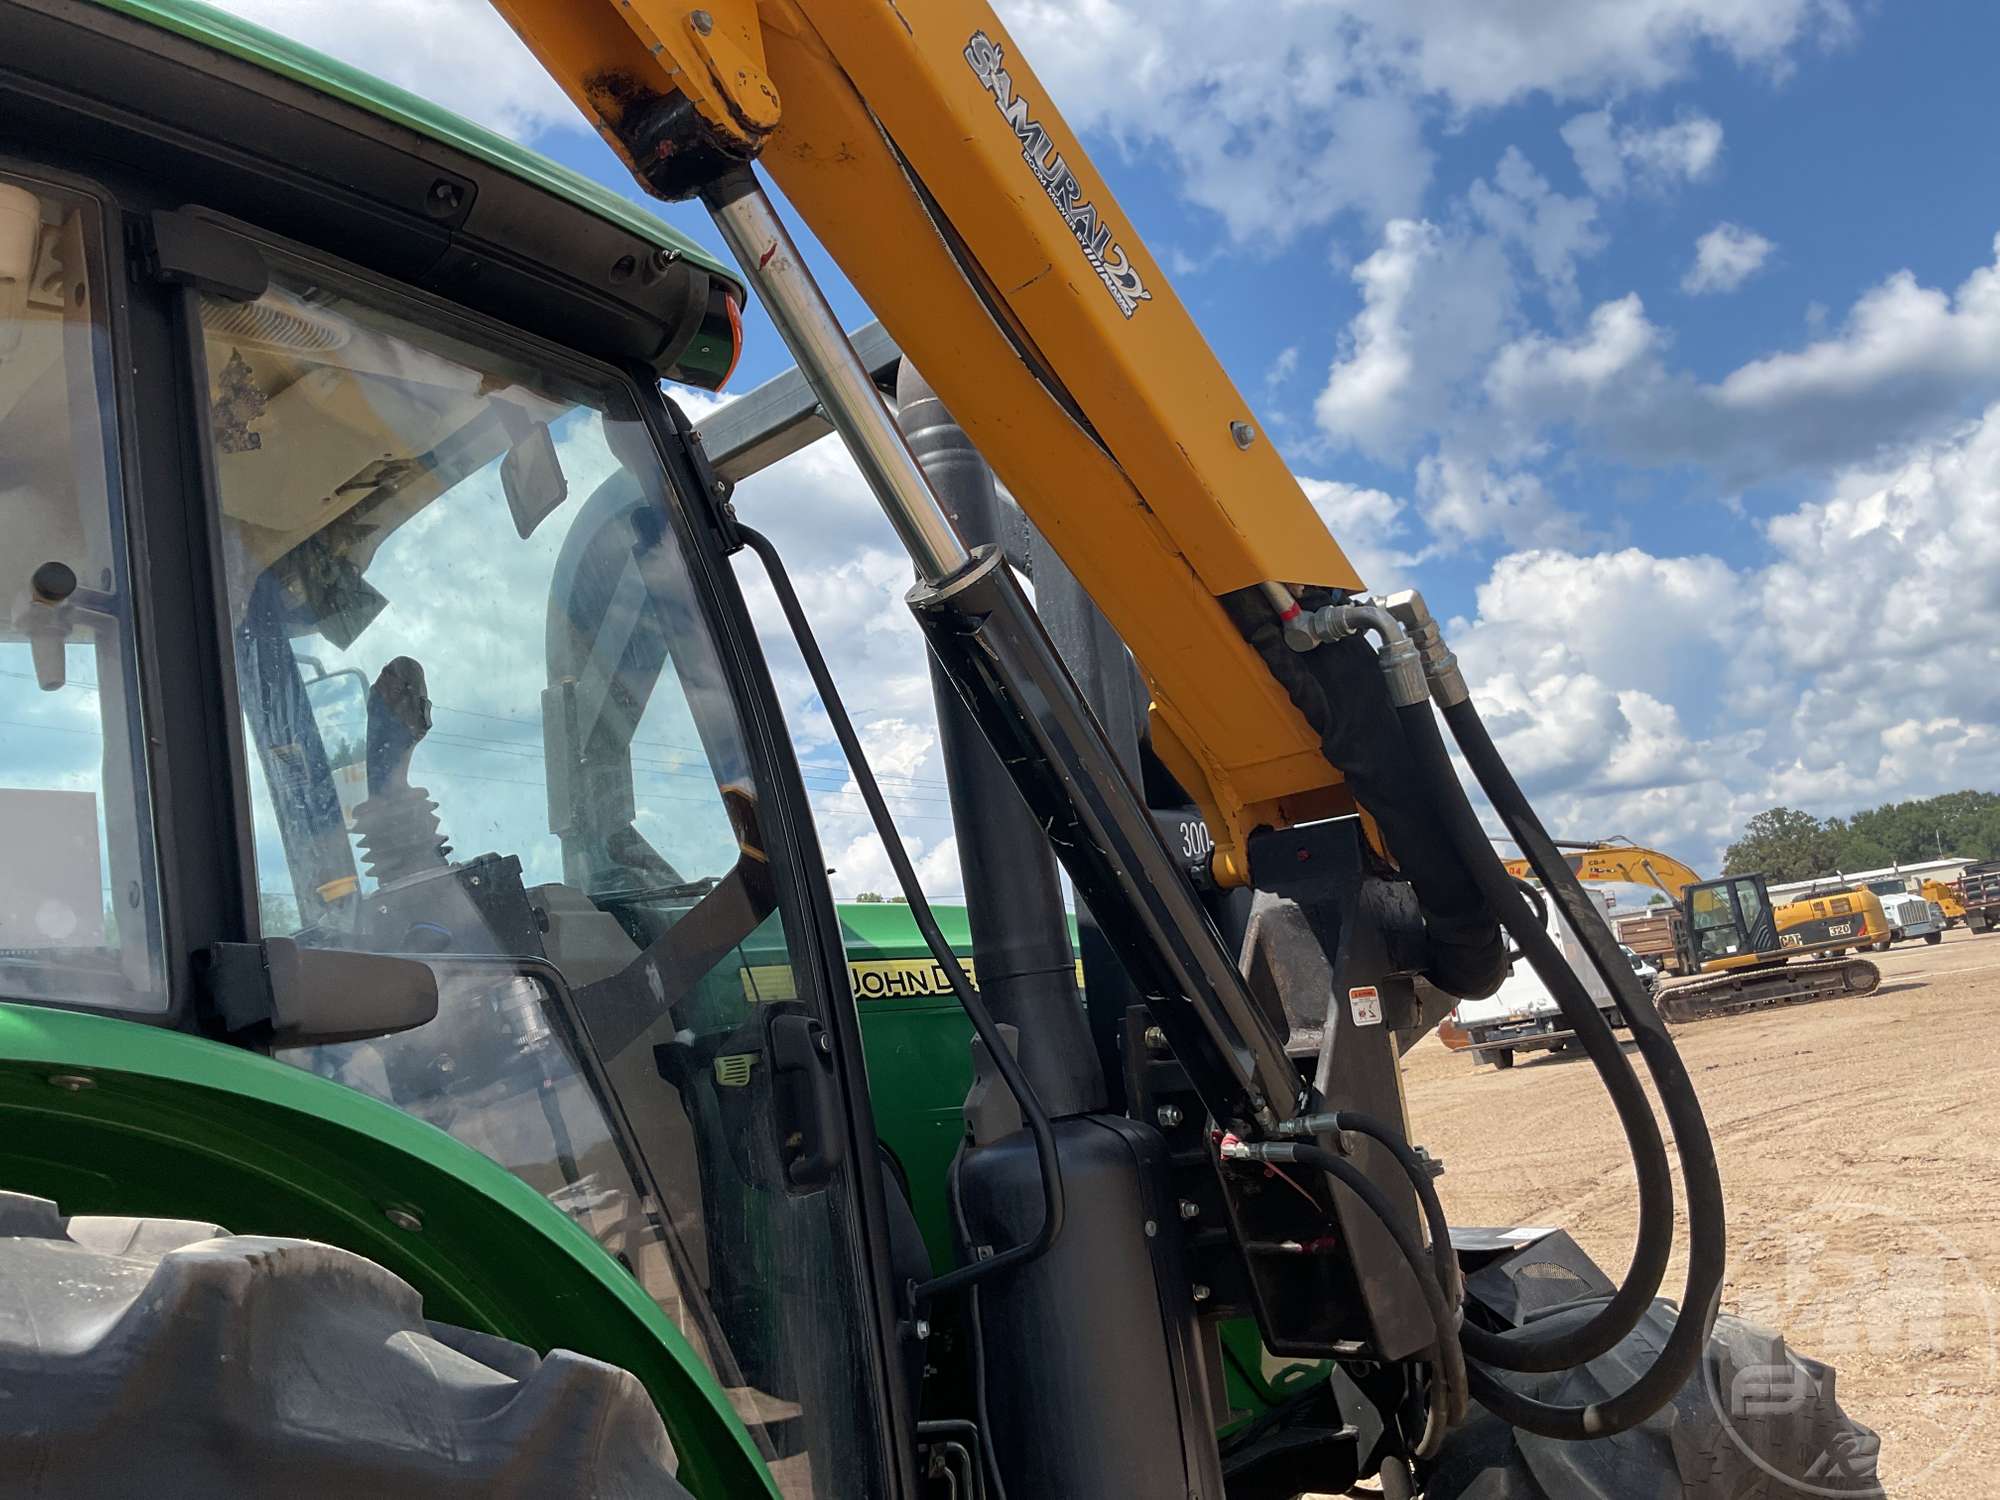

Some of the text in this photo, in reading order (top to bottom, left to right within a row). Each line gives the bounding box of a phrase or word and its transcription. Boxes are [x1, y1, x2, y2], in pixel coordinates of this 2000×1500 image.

[963, 29, 1112, 264] SAMURAI
[1022, 151, 1047, 187] BOOM
[1046, 186, 1076, 231] MOWER
[1074, 231, 1089, 247] BY
[1780, 934, 1802, 947] CAT
[853, 969, 927, 993] JOHN
